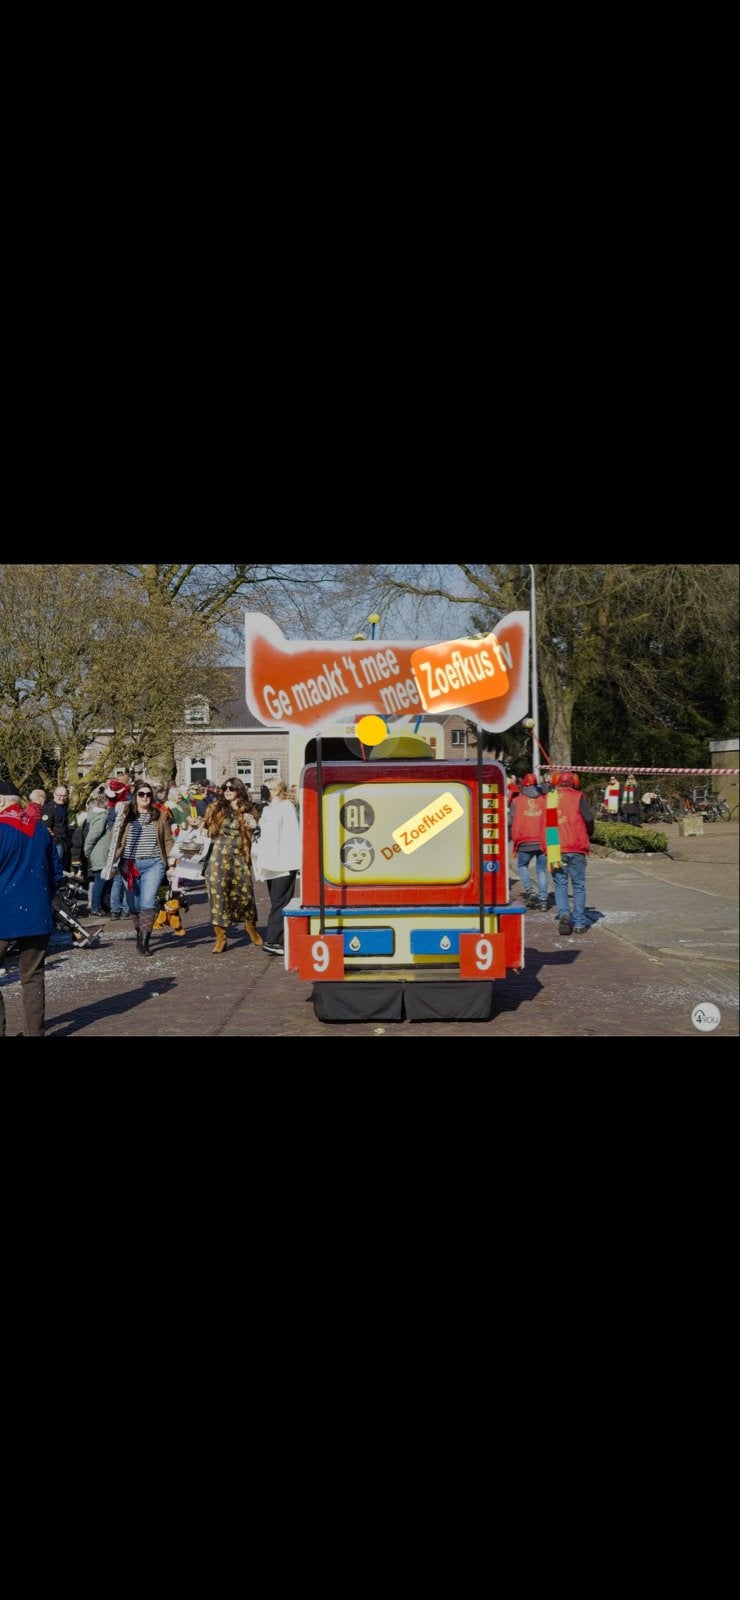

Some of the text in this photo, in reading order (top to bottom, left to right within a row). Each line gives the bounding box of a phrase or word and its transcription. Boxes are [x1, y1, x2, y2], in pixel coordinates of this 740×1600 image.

[263, 685, 292, 720] Ge
[292, 661, 349, 711] maokt
[360, 649, 400, 686] mee
[419, 650, 495, 699] Zoefkus
[494, 641, 514, 672] tv
[346, 805, 370, 828] AL
[487, 800, 494, 808] 2
[487, 815, 494, 823] 3
[381, 804, 453, 861] De Zoefkus
[487, 830, 494, 838] 7
[311, 940, 330, 973] 9
[475, 939, 494, 971] 9
